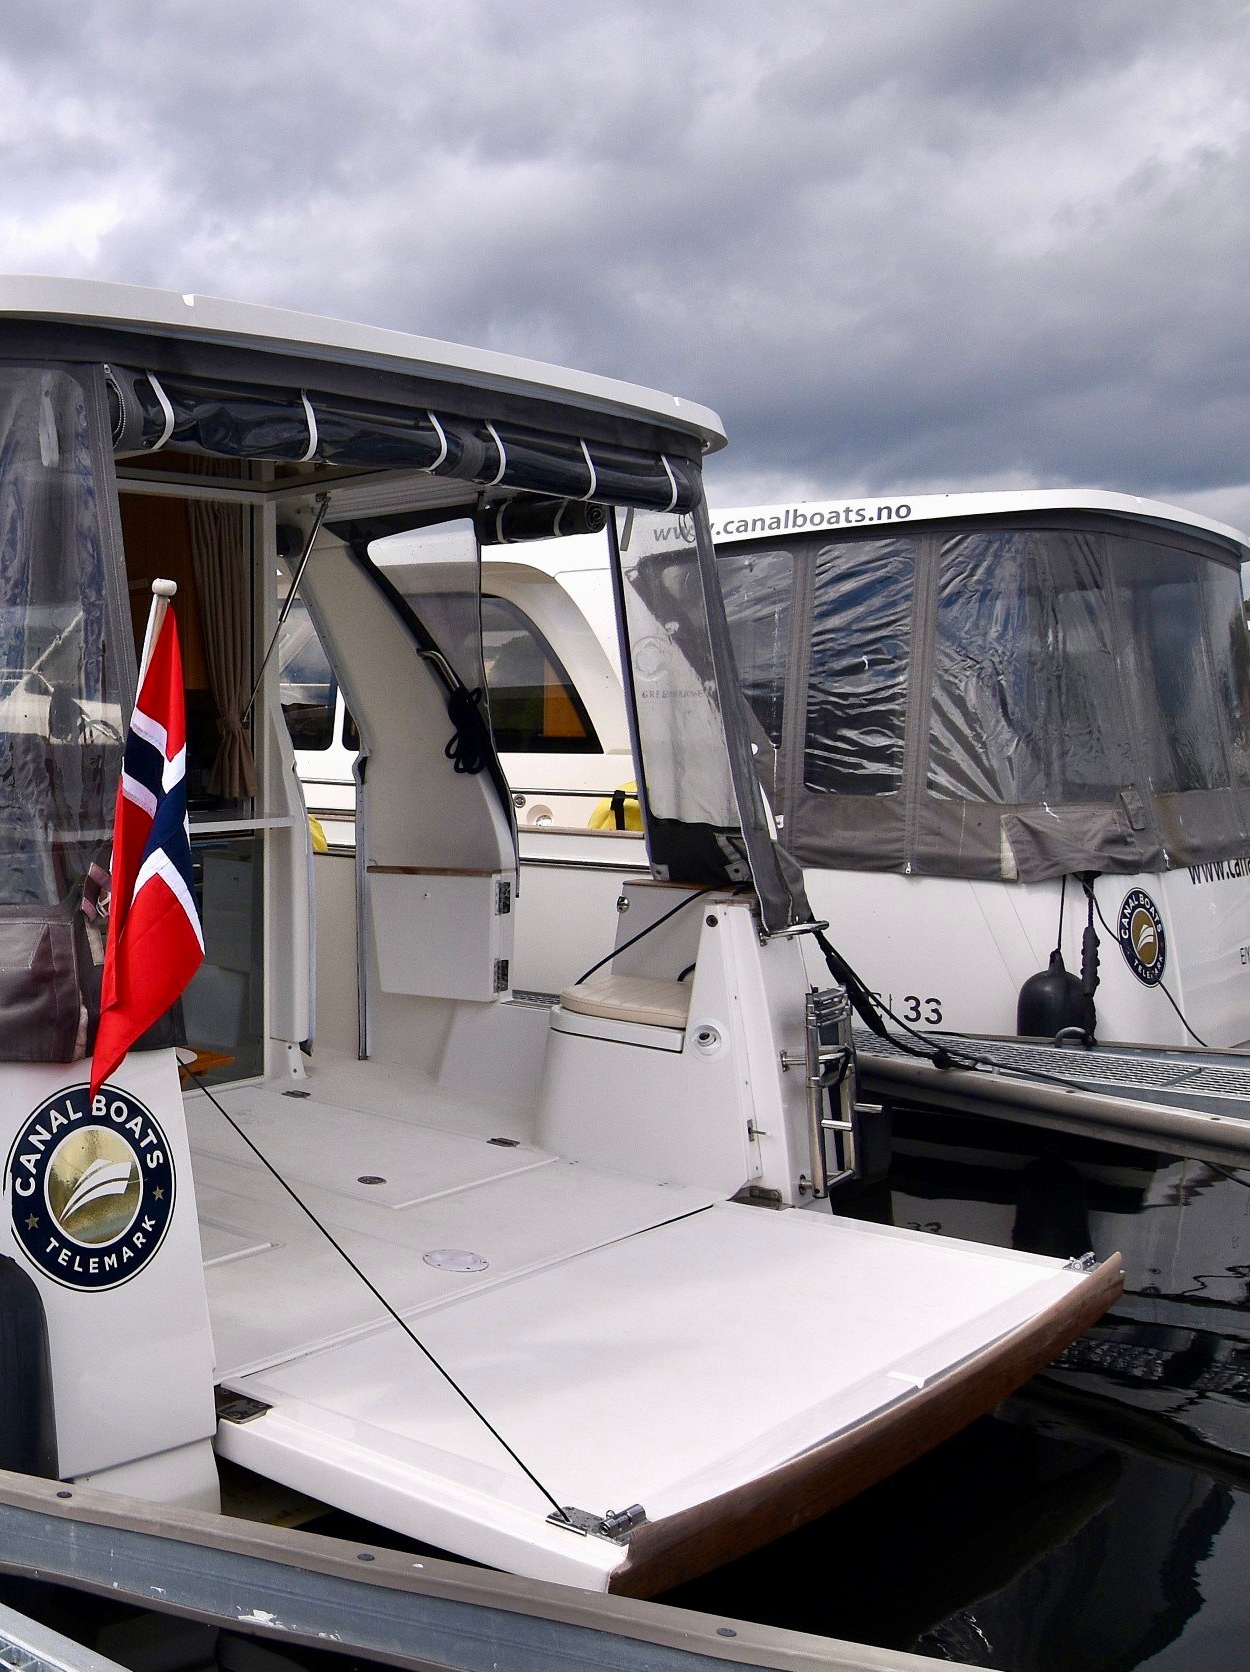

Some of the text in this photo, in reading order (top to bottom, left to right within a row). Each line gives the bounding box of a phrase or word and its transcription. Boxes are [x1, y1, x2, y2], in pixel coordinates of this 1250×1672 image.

[1121, 893, 1162, 939] CANAL BOATS
[903, 995, 942, 1025] 33
[15, 1094, 164, 1197] CANAL BOATS
[45, 1214, 156, 1274] TELEMARK
